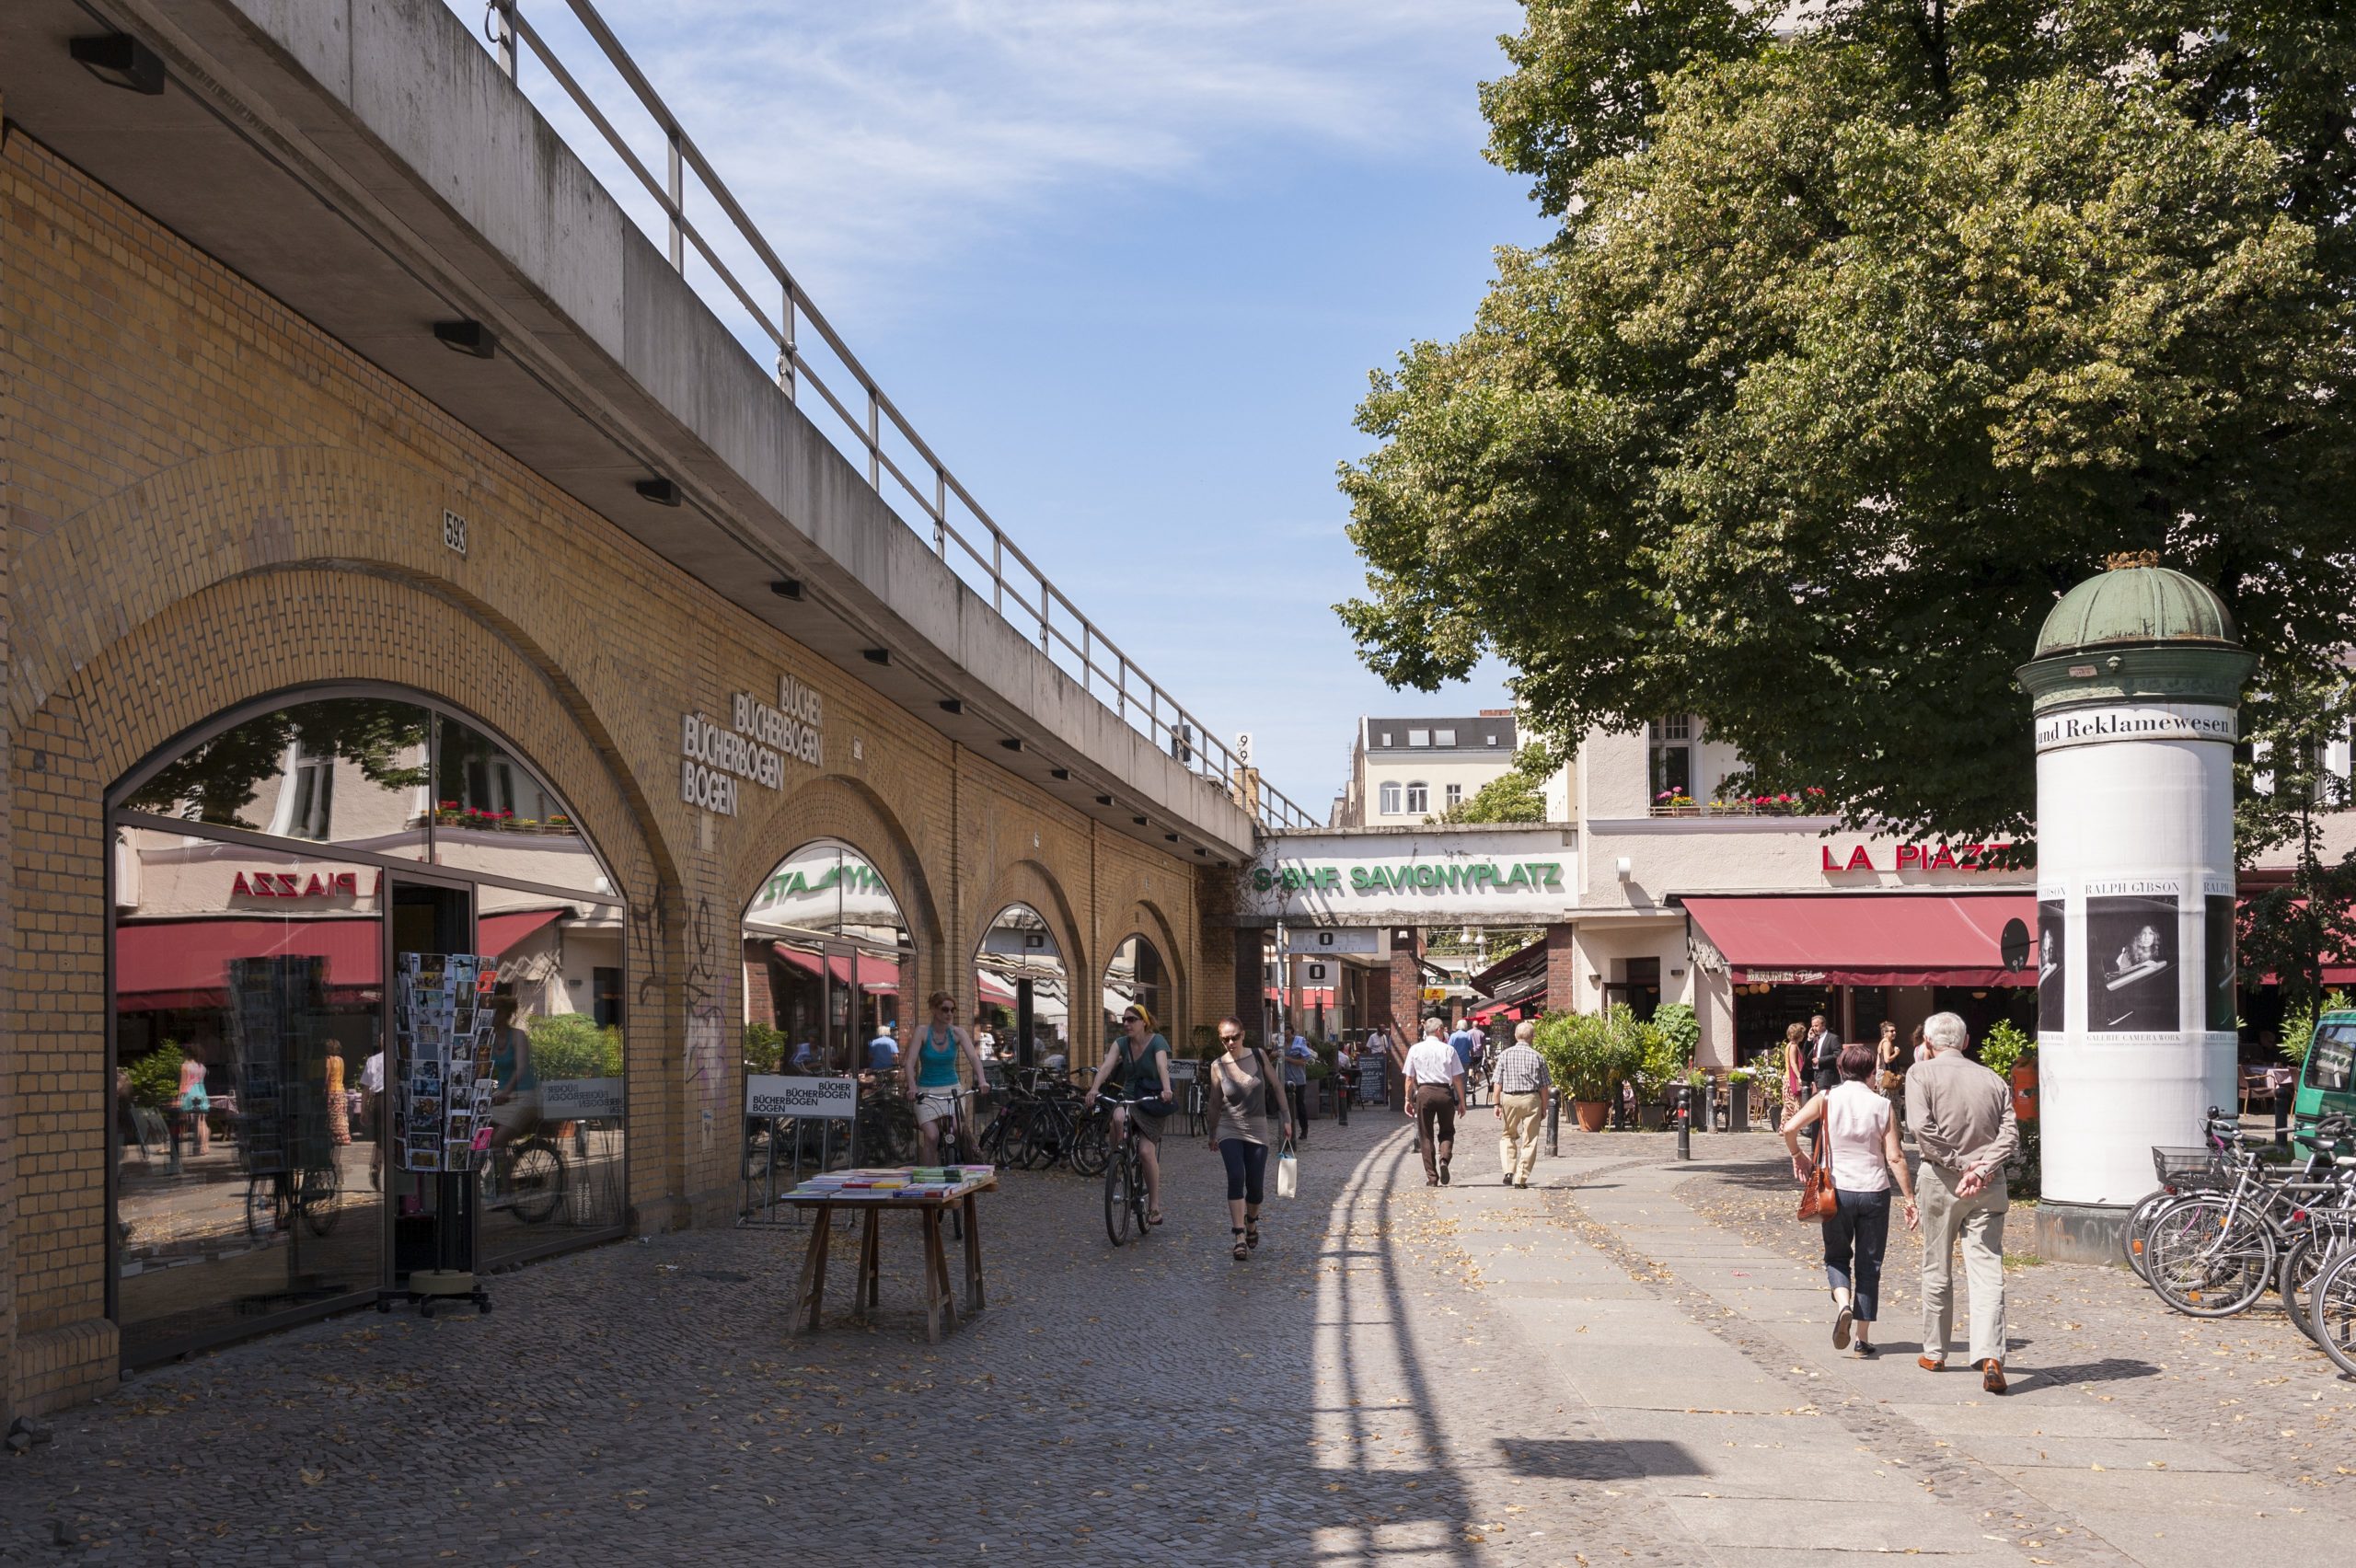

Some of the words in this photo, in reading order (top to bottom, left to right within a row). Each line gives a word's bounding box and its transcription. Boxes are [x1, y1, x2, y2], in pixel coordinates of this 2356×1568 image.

[445, 512, 466, 550] 593
[780, 673, 823, 728] BÜCHER
[733, 691, 823, 767] BÜCHERBOGEN
[2038, 721, 2060, 744] und
[2067, 714, 2229, 738] Reklamewesen
[683, 711, 784, 790] BÜCHERBOGEN
[683, 760, 737, 817] BOGEN
[1822, 846, 1875, 870] LA
[1350, 862, 1561, 889] SAVIGNYPLATZ
[2085, 883, 2127, 894] RALPH
[2131, 882, 2180, 893] GIBSON
[786, 1088, 851, 1100] BÜCHERBOGEN
[818, 1081, 851, 1091] BÜCHER
[753, 1094, 818, 1106] BÜCHERBOGEN
[753, 1103, 786, 1113] BOGEN
